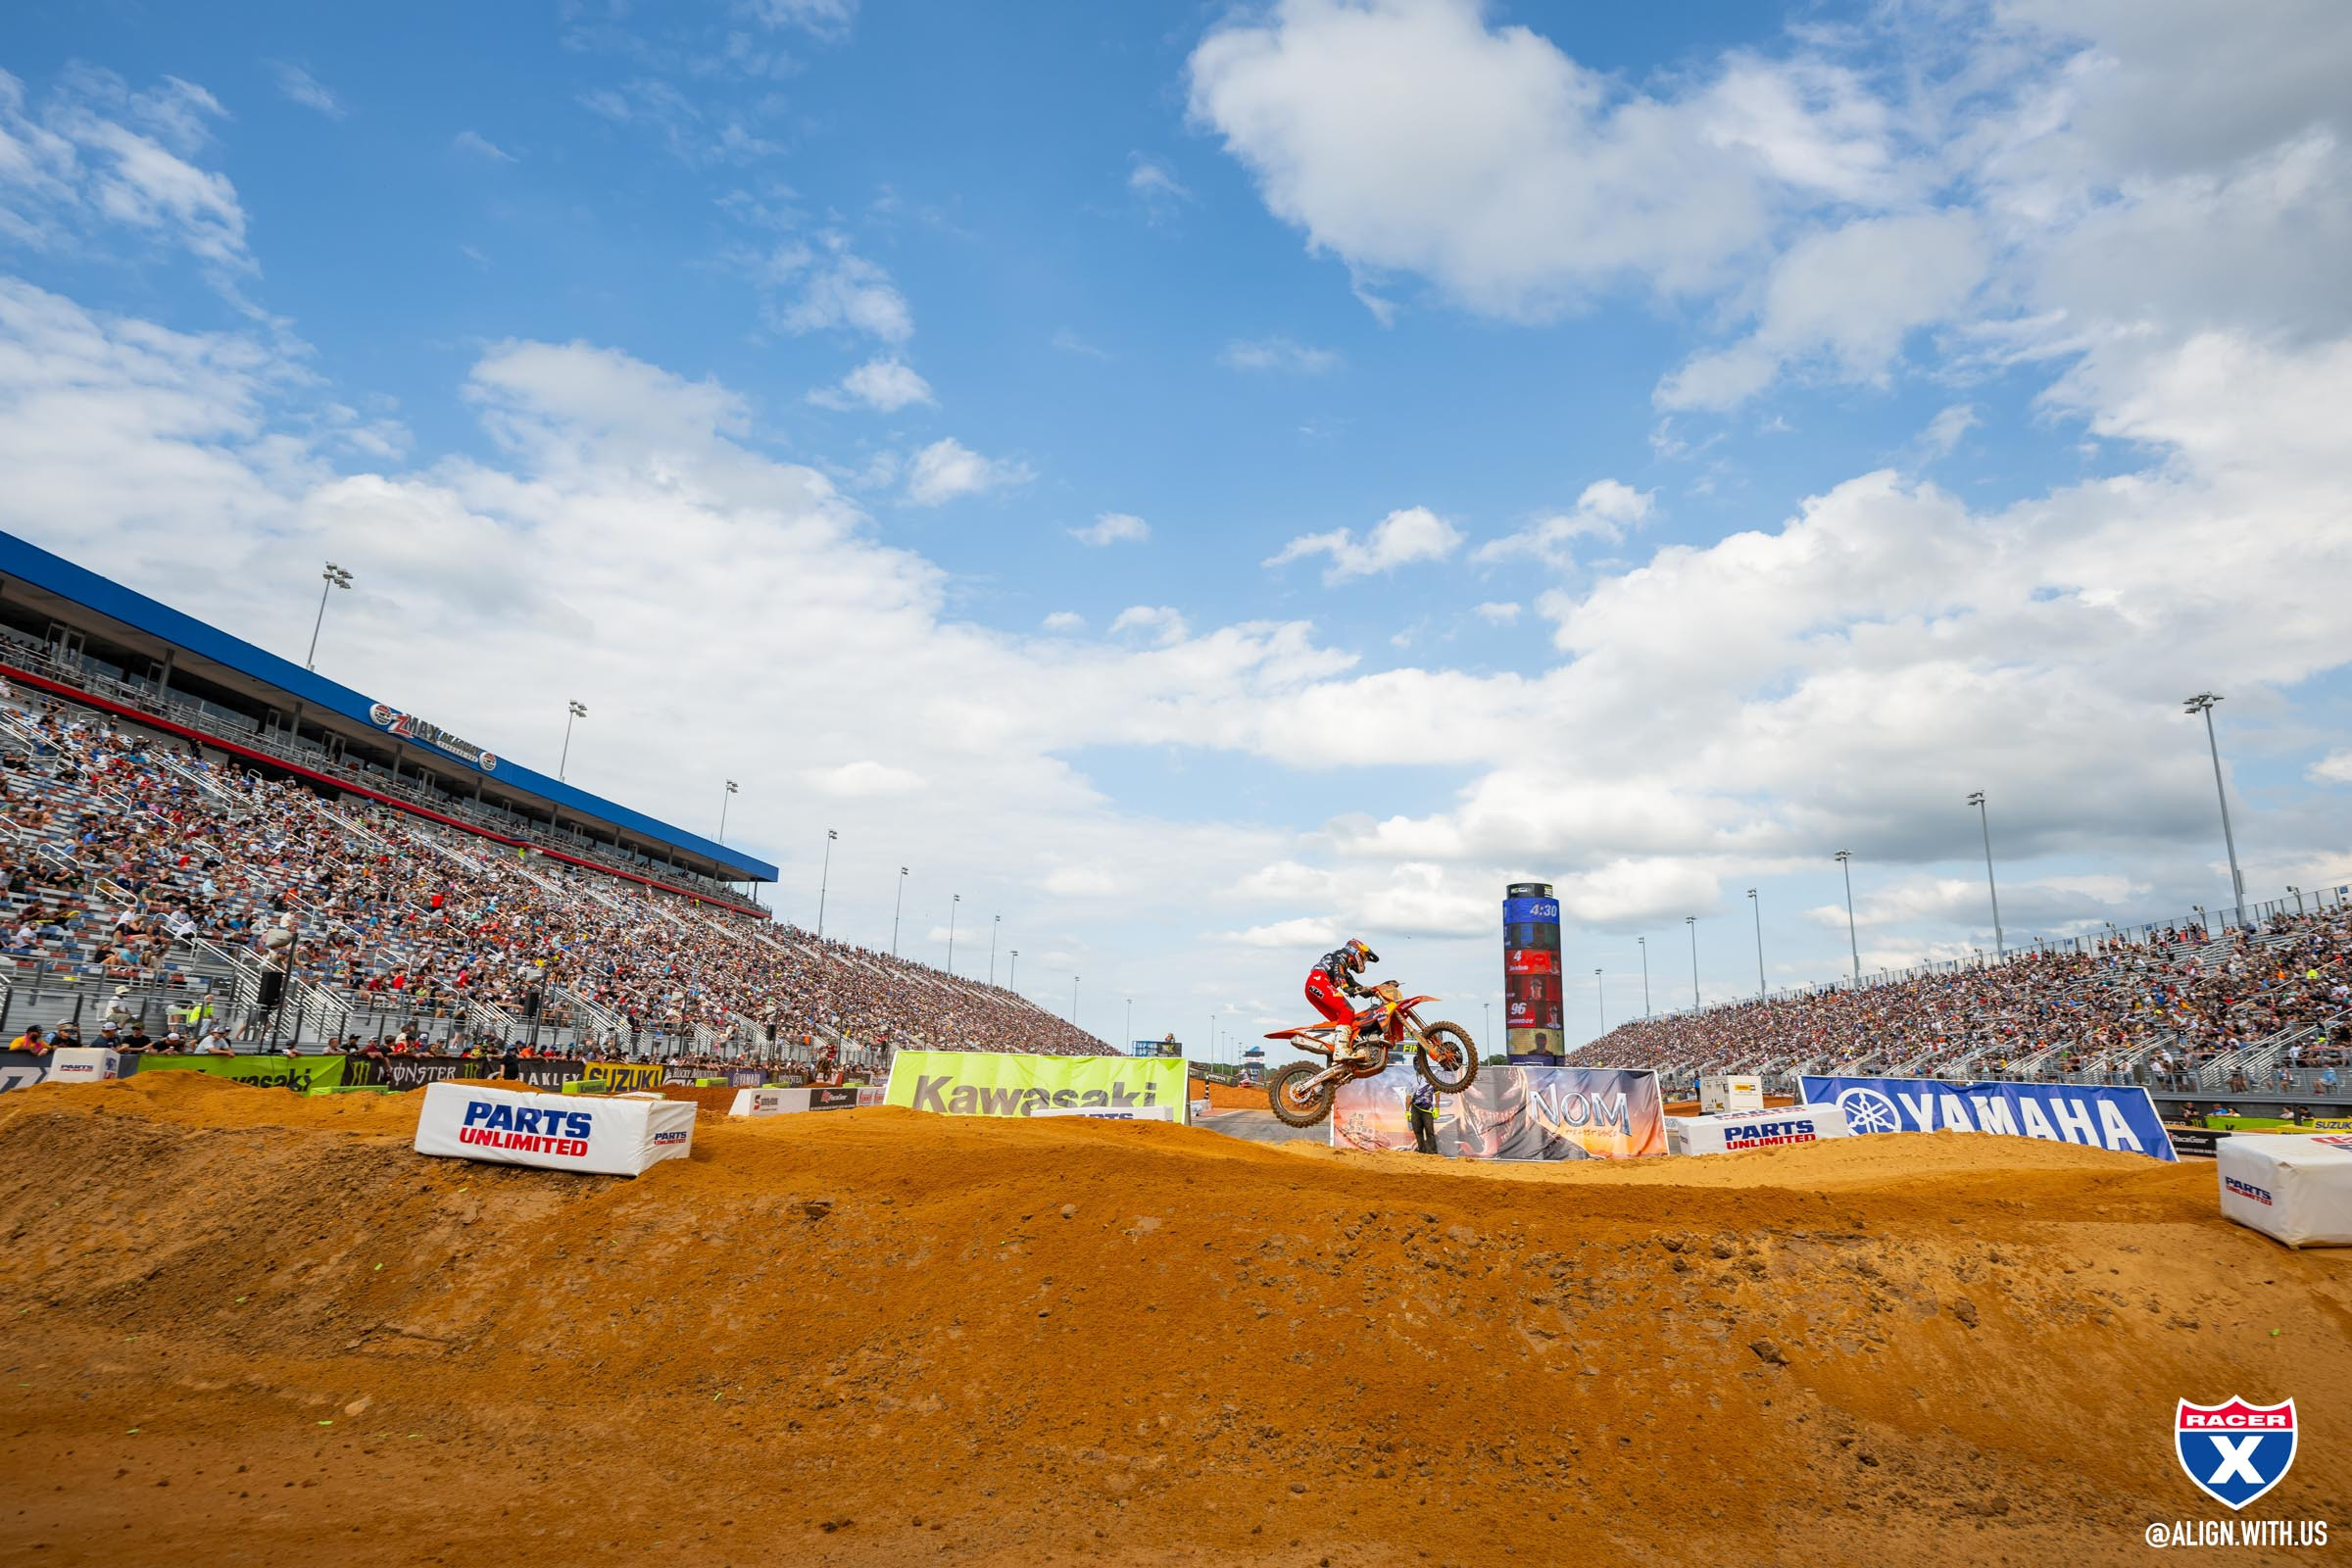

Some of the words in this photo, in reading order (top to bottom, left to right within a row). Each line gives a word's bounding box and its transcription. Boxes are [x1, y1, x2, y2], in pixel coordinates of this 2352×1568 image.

[1530, 903, 1557, 917] 4:30
[1513, 950, 1522, 961] 4
[1308, 985, 1325, 999] KTM
[1510, 1002, 1527, 1015] 96
[912, 1075, 1157, 1116] Kawasaki
[464, 1101, 592, 1139] PARTS
[1897, 1093, 2144, 1152] YAMAHA
[2315, 1120, 2352, 1130] SUZUK
[654, 1130, 687, 1141] PARTS
[1724, 1119, 1815, 1142] PARTS
[459, 1127, 589, 1157] UNLIMITED
[1726, 1133, 1816, 1151] UNLIMITED
[2225, 1176, 2272, 1200] PARTS
